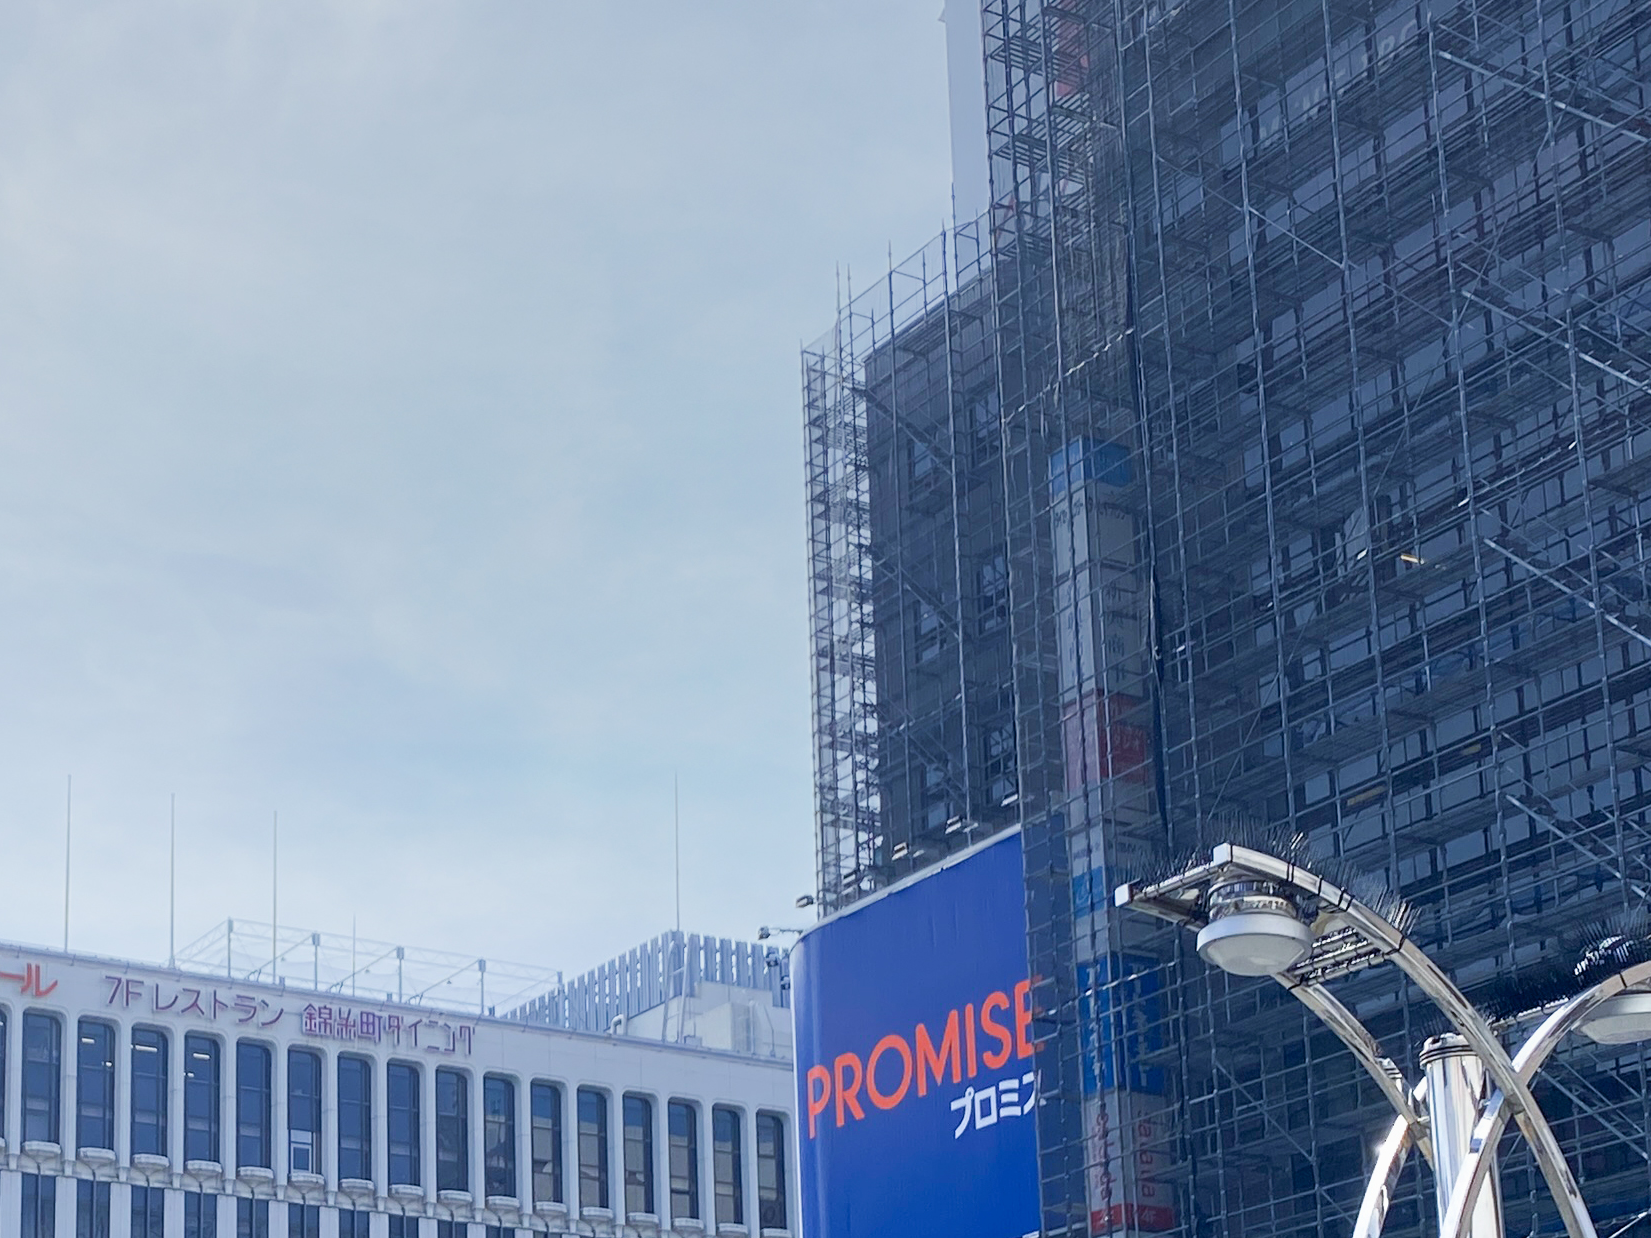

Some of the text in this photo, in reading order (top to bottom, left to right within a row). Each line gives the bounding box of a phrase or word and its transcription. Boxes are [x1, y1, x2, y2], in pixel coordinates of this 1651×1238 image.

[105, 975, 144, 1007] 7F
[155, 982, 284, 1026] レストラン
[806, 974, 1045, 1140] PROMISE
